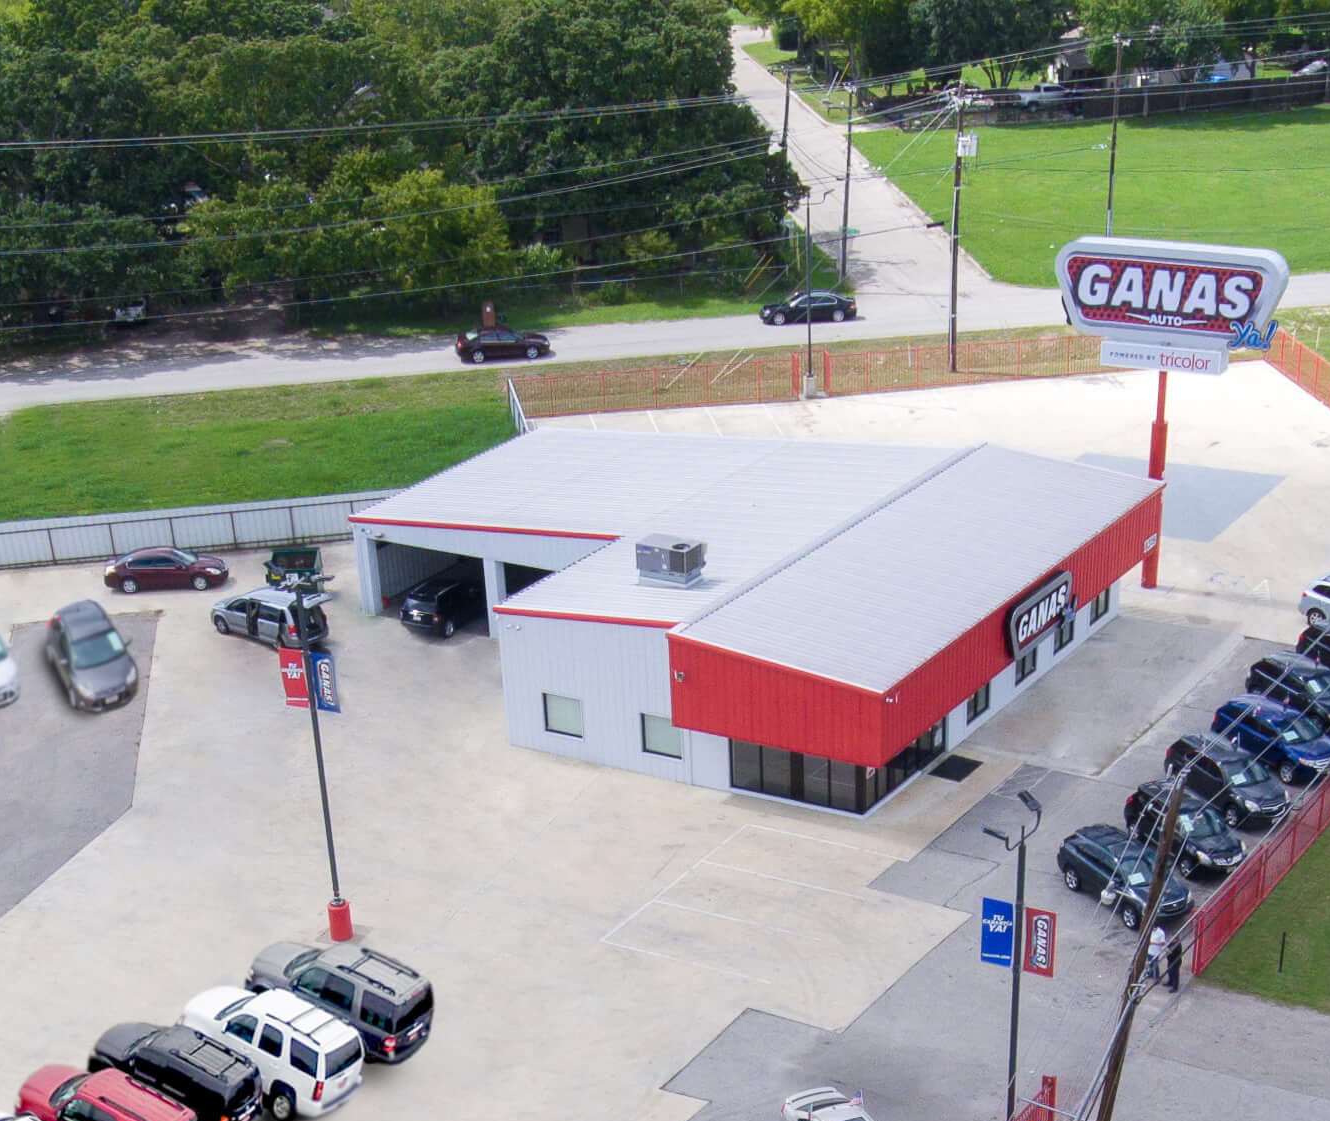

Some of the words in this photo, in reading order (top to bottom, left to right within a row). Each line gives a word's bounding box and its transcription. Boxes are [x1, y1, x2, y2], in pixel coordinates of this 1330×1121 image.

[1077, 263, 1254, 319] GANAS
[1148, 313, 1183, 327] AUTO
[1229, 320, 1278, 350] Ya!
[1109, 351, 1144, 360] POWERED
[1160, 351, 1211, 371] tricolor
[1019, 584, 1067, 643] GANAS
[1036, 919, 1048, 966] GANAS
